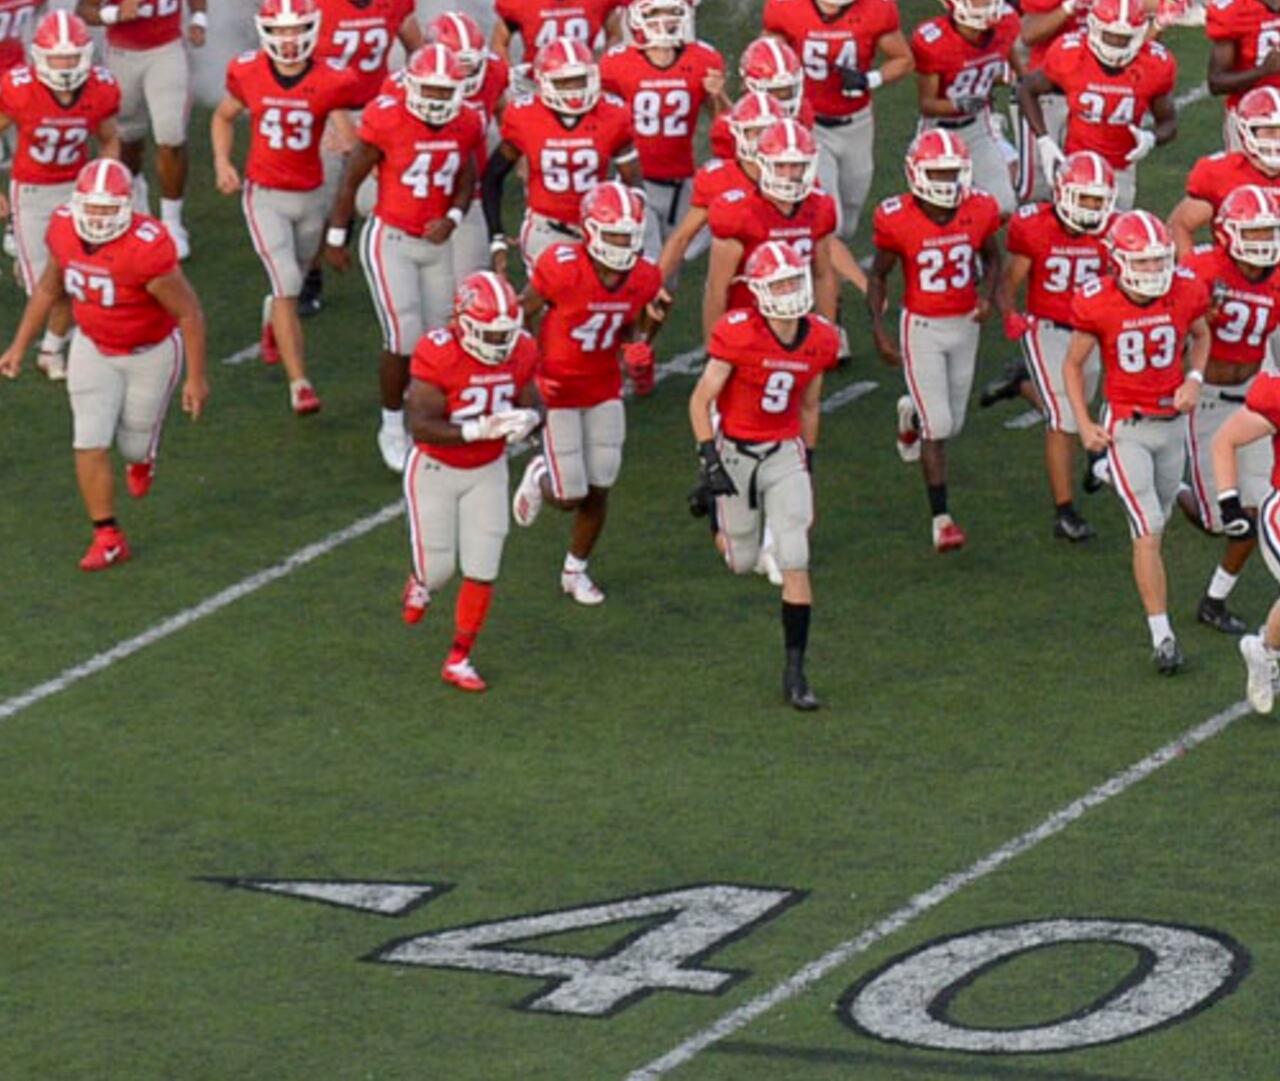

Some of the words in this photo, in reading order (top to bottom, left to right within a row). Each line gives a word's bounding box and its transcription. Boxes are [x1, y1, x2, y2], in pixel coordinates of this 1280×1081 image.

[326, 27, 389, 72] 73
[802, 40, 858, 81] 54
[259, 107, 314, 152] 43
[633, 89, 691, 137] 82
[28, 126, 89, 166] 32
[401, 152, 461, 199] 44
[540, 147, 600, 193] 52
[917, 243, 974, 293] 23
[1043, 255, 1102, 293] 35
[570, 311, 624, 353] 41
[1216, 301, 1270, 346] 31
[1116, 324, 1178, 374] 83
[761, 370, 796, 413] 9
